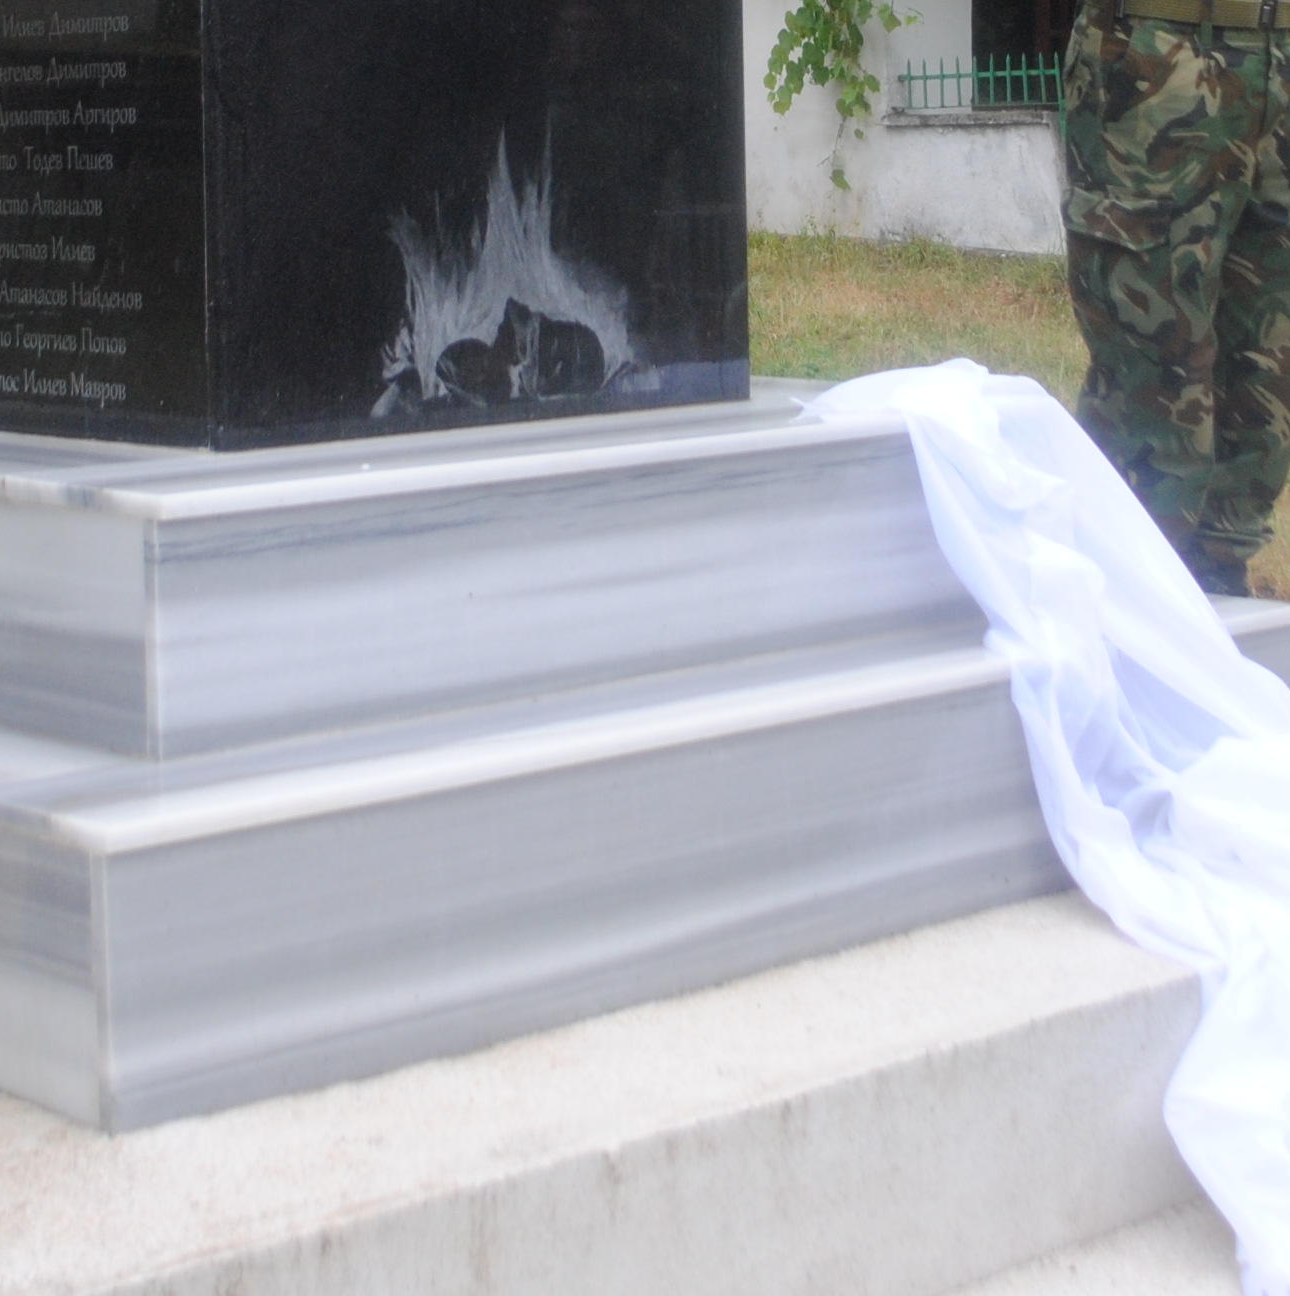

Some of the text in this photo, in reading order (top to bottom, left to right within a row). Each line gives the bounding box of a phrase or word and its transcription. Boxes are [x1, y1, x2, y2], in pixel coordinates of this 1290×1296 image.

[1, 14, 45, 39] Илиев
[48, 11, 129, 43] Димитров
[45, 56, 126, 89] Димитров
[72, 101, 136, 135] Аргиров
[67, 145, 113, 171] Пешев
[30, 191, 102, 217] Атанасов
[51, 236, 95, 263] Илиев
[71, 281, 143, 313] Найденов
[14, 323, 77, 359] Георгиев
[81, 327, 126, 356] Попов
[22, 368, 66, 397] Илиев
[69, 372, 126, 410] Мавров
